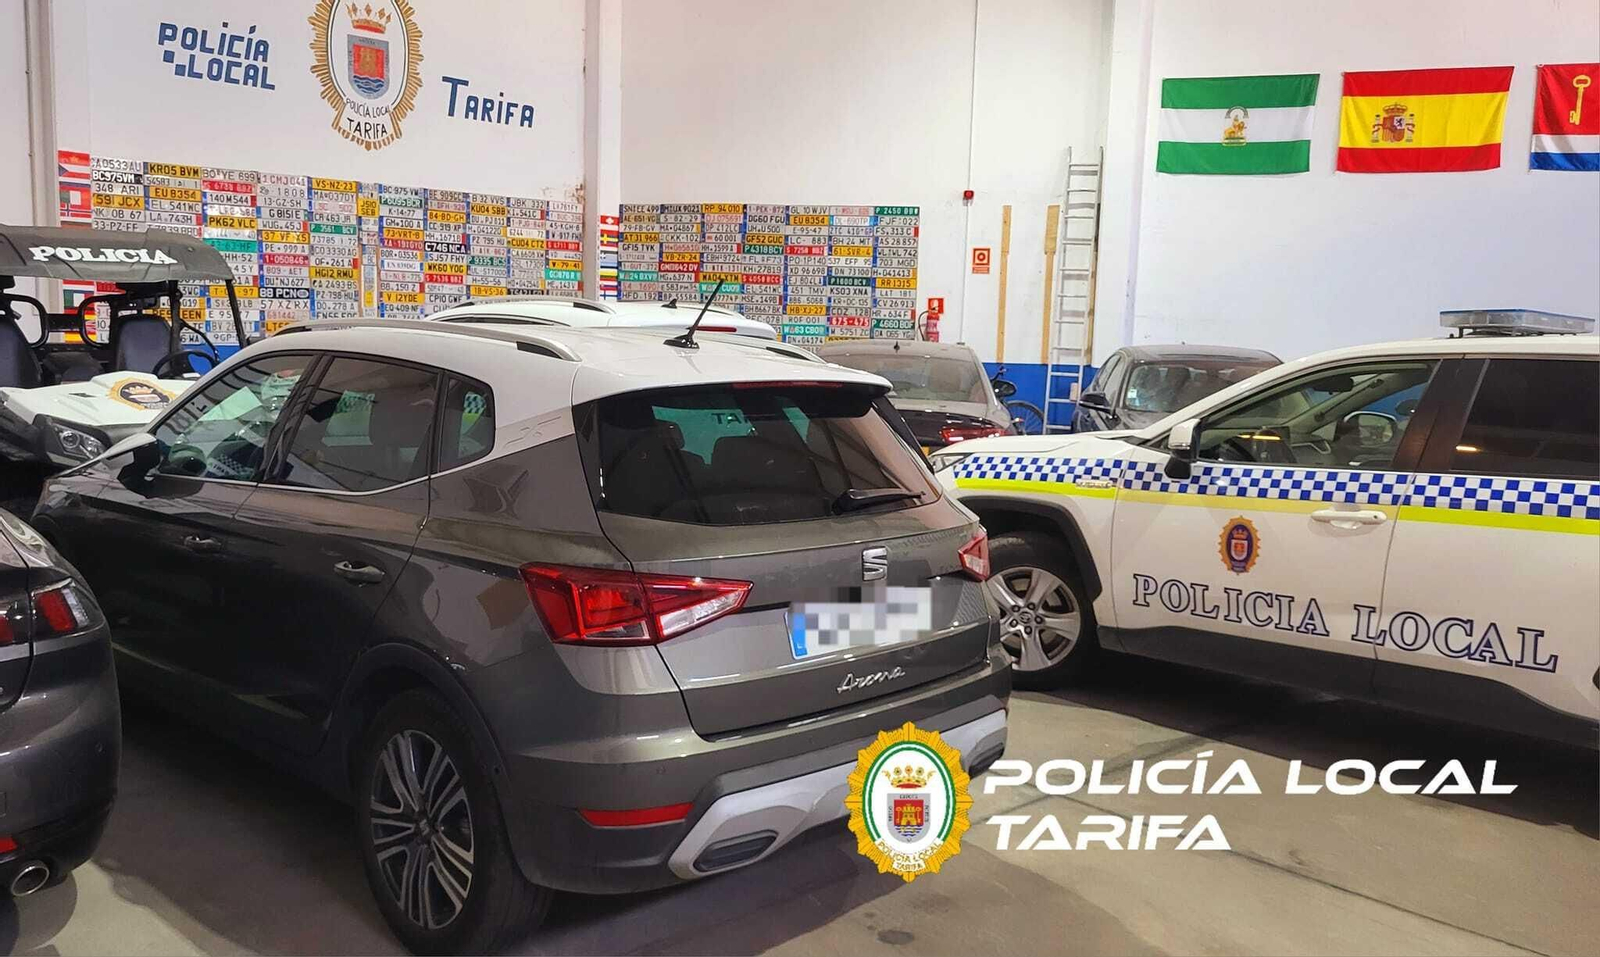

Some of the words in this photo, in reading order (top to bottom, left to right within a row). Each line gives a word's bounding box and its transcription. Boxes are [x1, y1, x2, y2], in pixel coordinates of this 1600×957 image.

[188, 54, 276, 90] LOCAL
[347, 117, 388, 140] TARIFA
[96, 183, 114, 192] 348
[154, 188, 168, 198] EU
[209, 217, 234, 228] PK62
[28, 246, 178, 265] POLICIA
[1132, 573, 1330, 637] POLICIA
[1351, 603, 1558, 673] LOCAL
